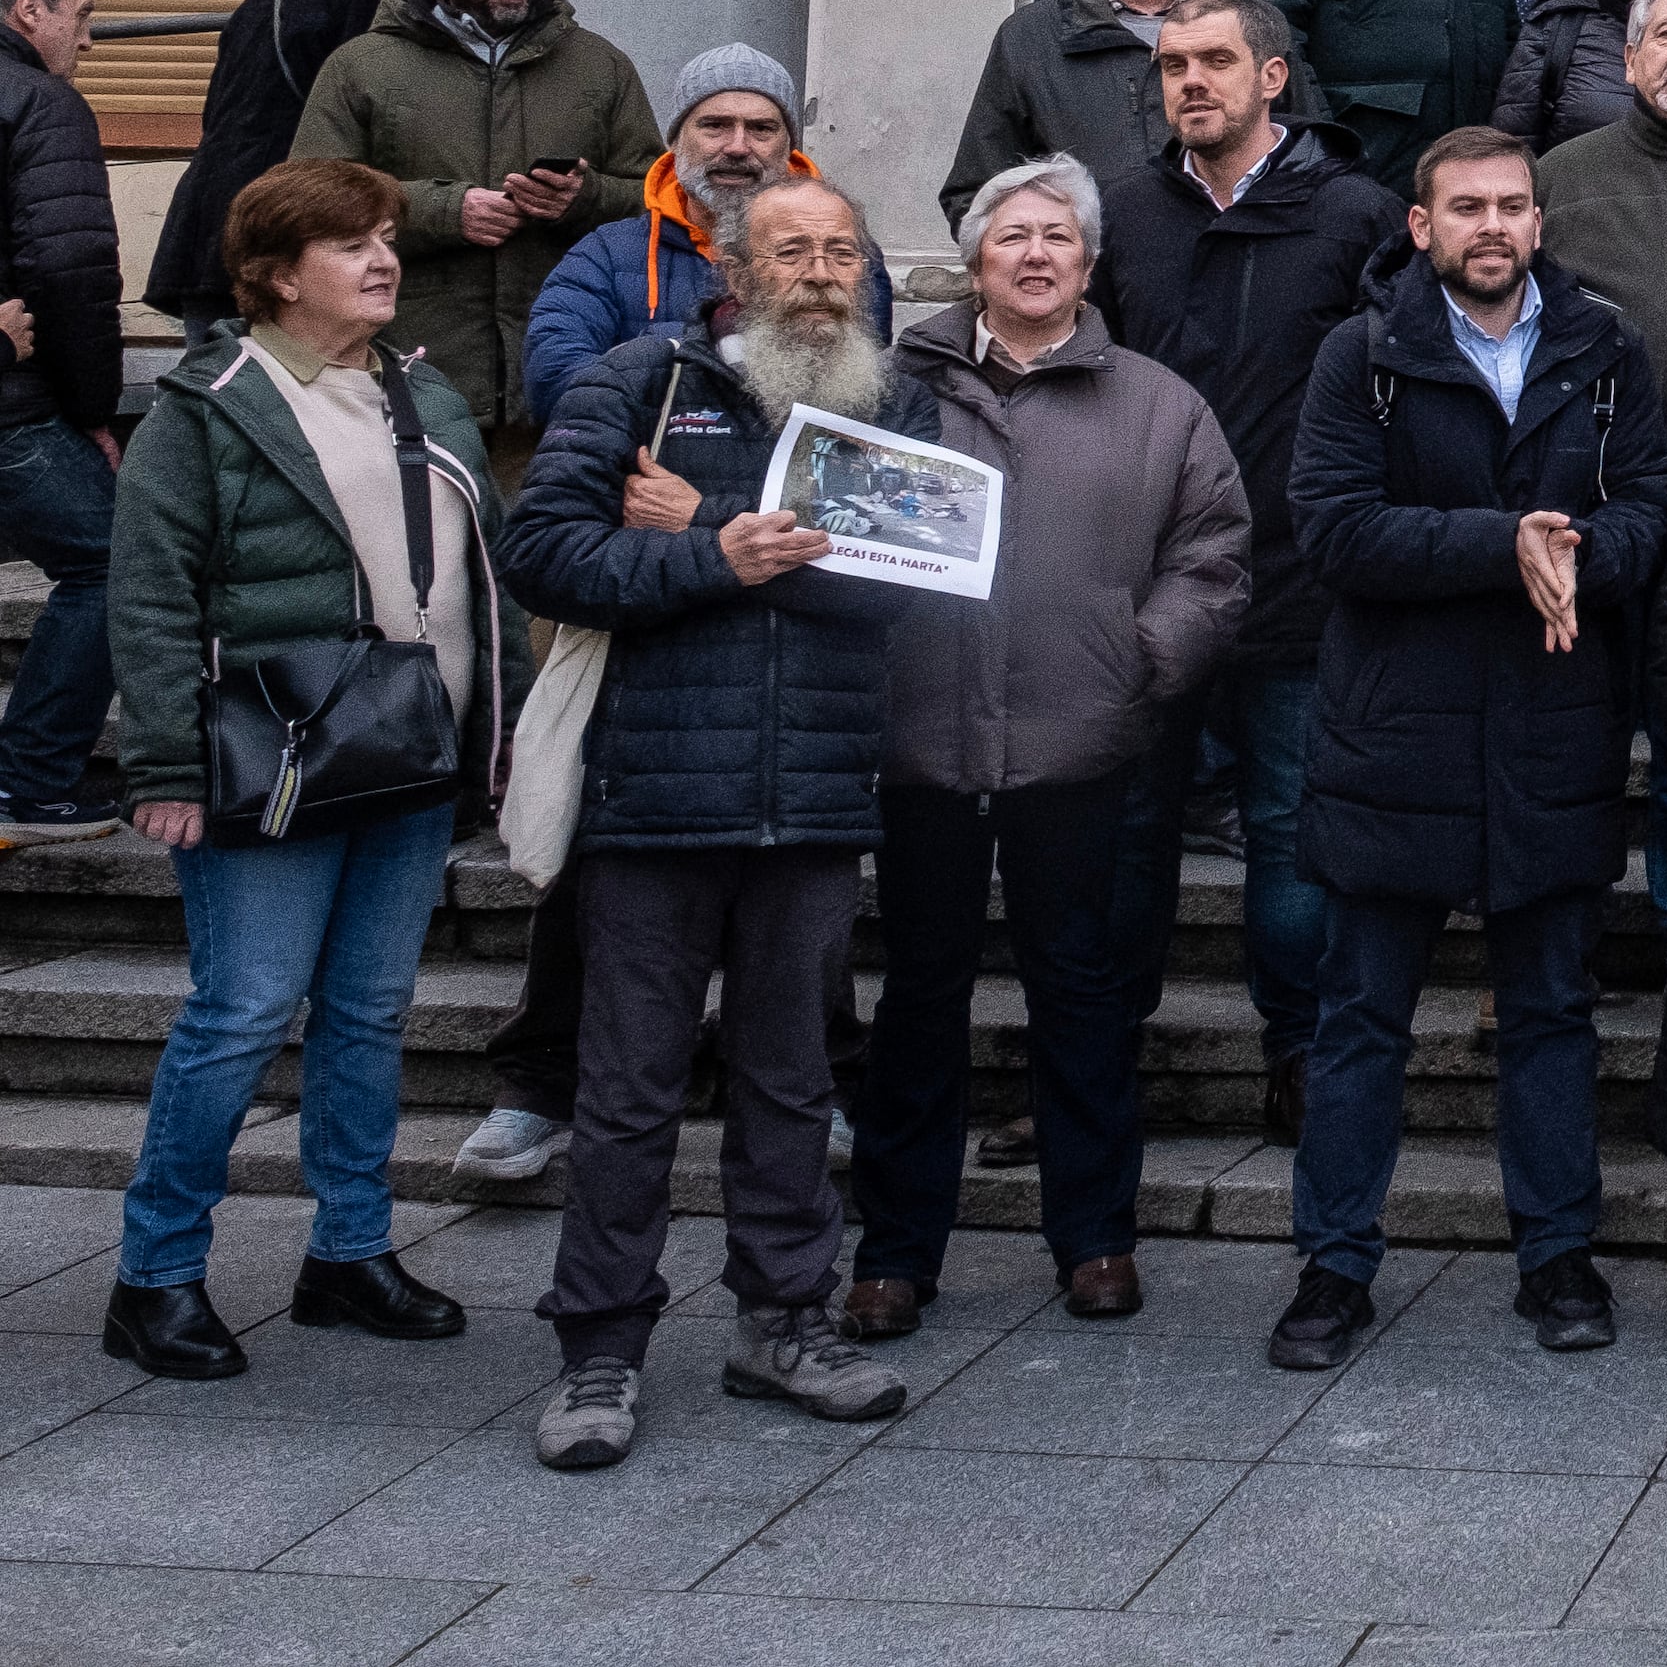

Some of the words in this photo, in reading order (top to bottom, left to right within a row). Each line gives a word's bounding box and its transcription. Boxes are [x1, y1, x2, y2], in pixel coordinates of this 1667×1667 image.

[686, 425, 703, 433] Sea
[829, 545, 867, 561] LECAS
[869, 552, 898, 565] ESTA
